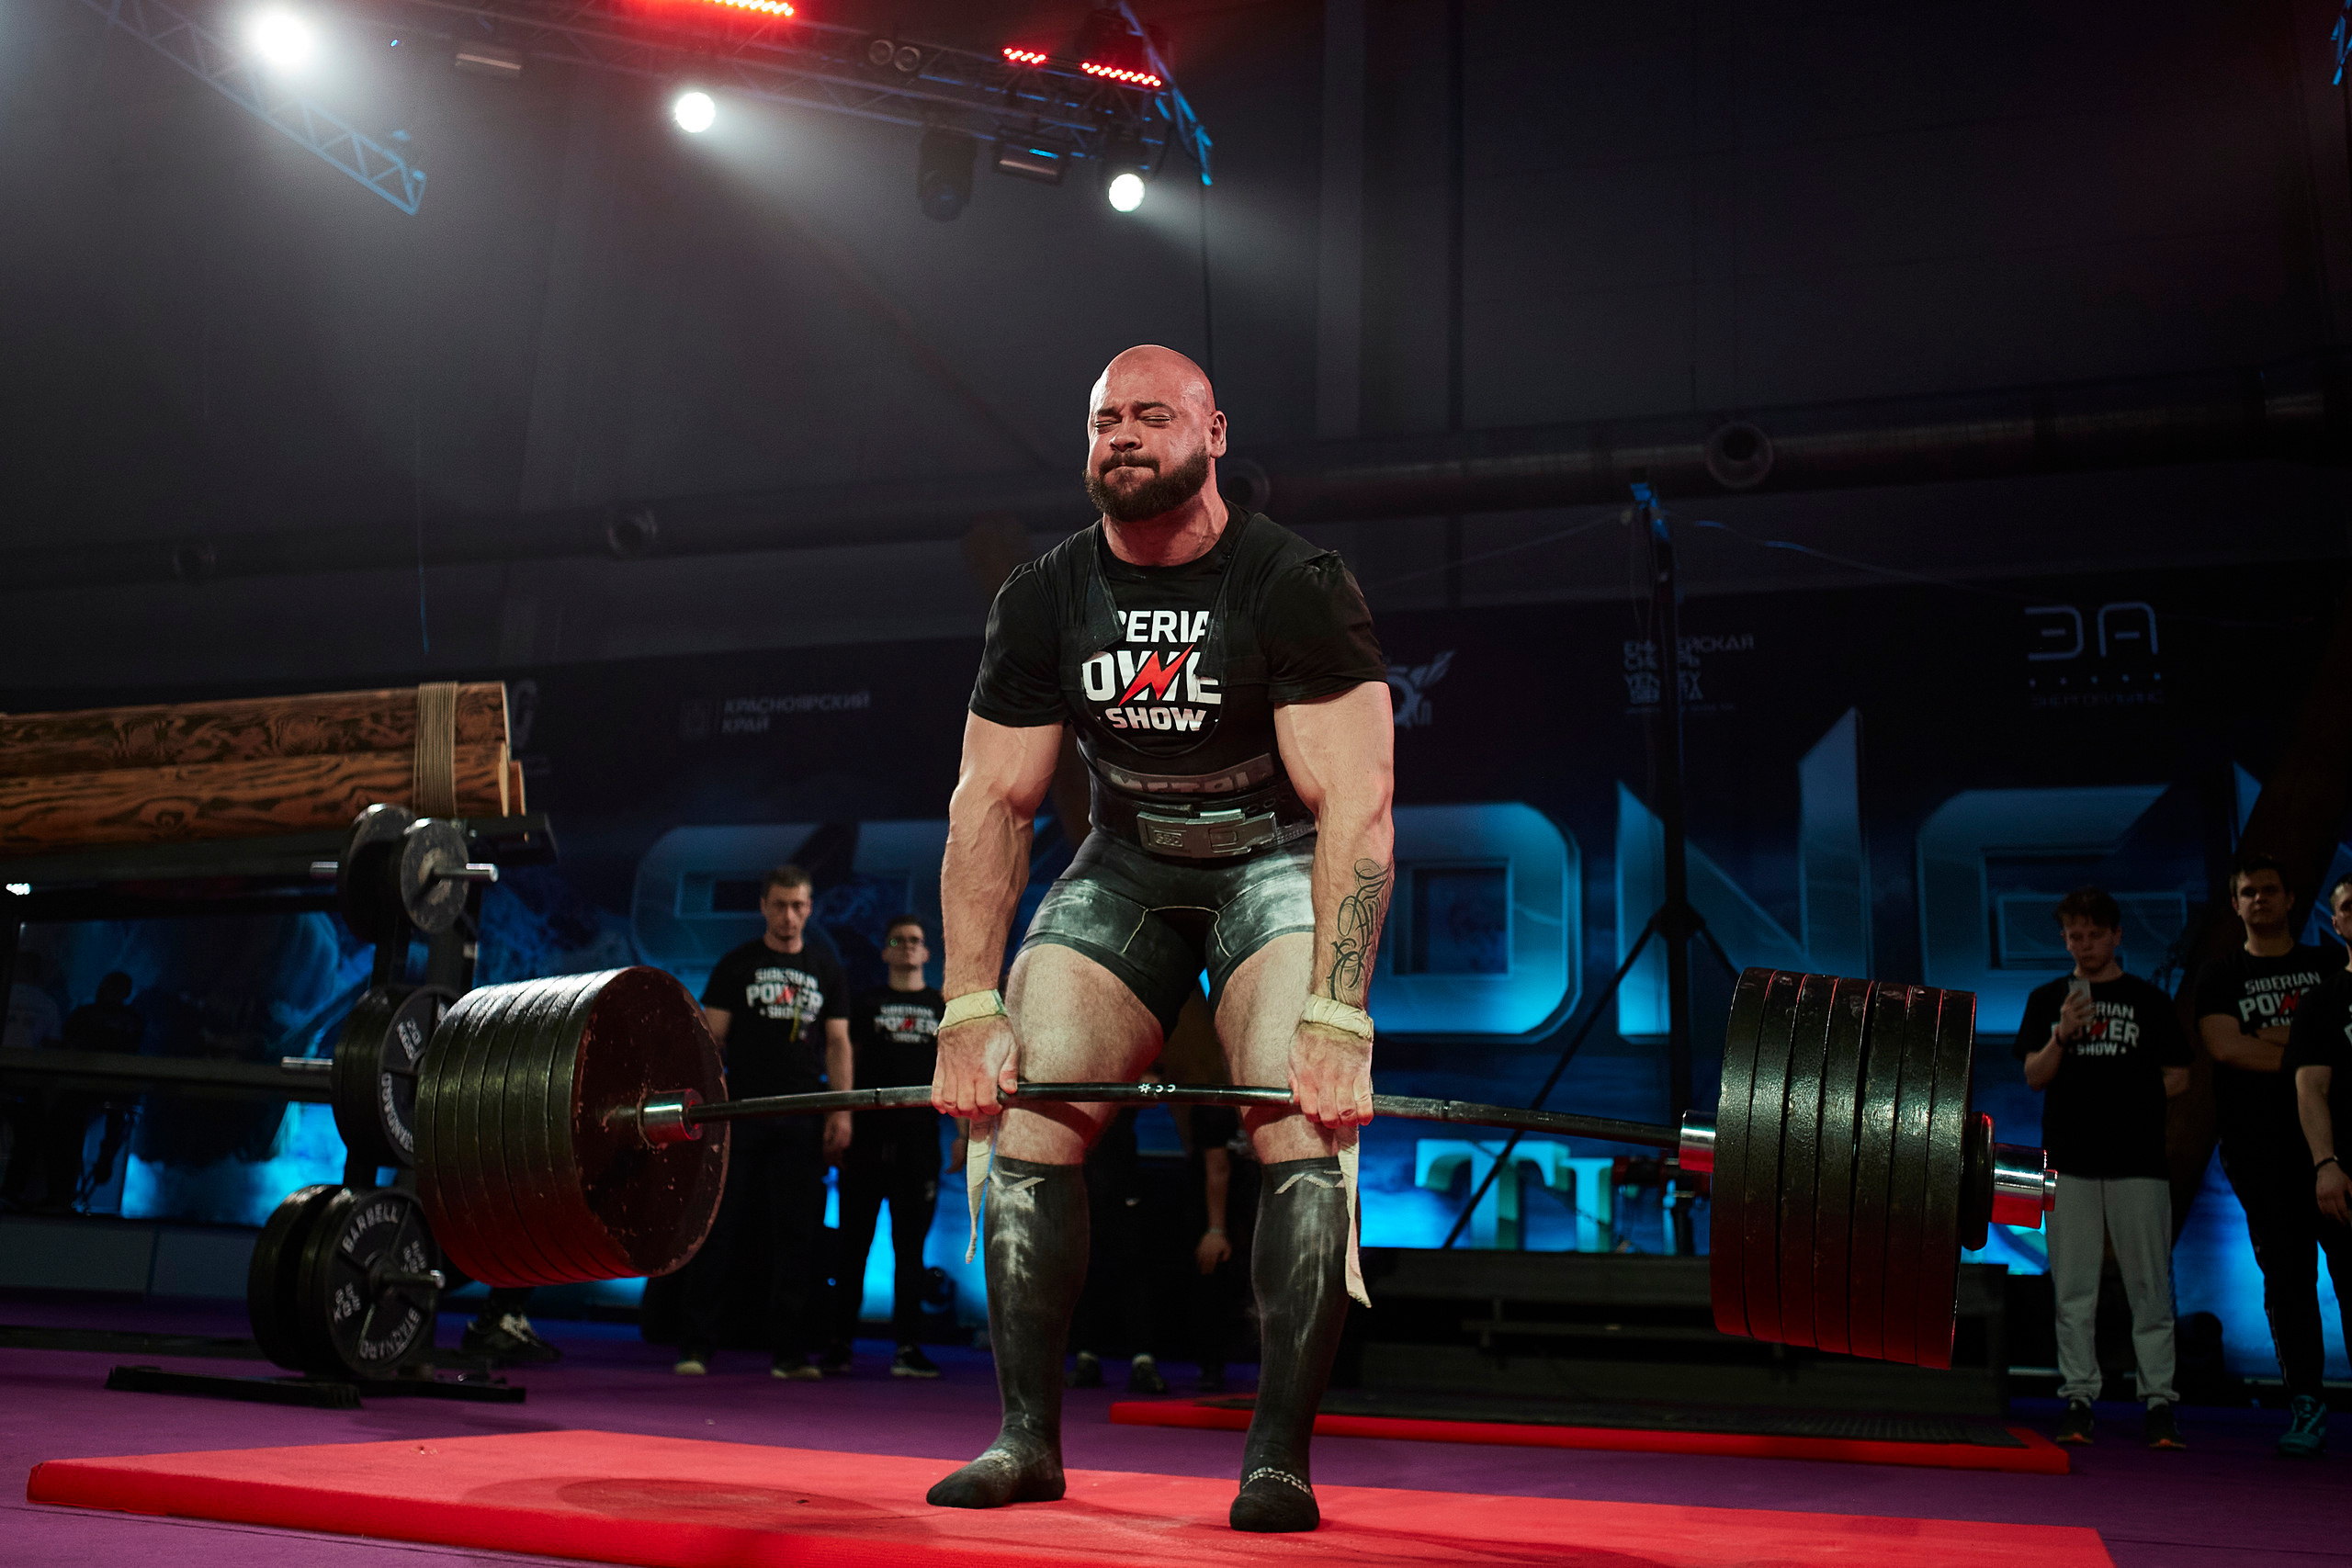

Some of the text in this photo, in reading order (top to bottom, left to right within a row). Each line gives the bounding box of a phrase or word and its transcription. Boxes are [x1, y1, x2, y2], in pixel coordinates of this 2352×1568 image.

[1105, 706, 1207, 732] SHOW
[2244, 971, 2322, 995] SIBERIAN
[2076, 1042, 2119, 1056] SHOW
[342, 1202, 400, 1256] BARBELL
